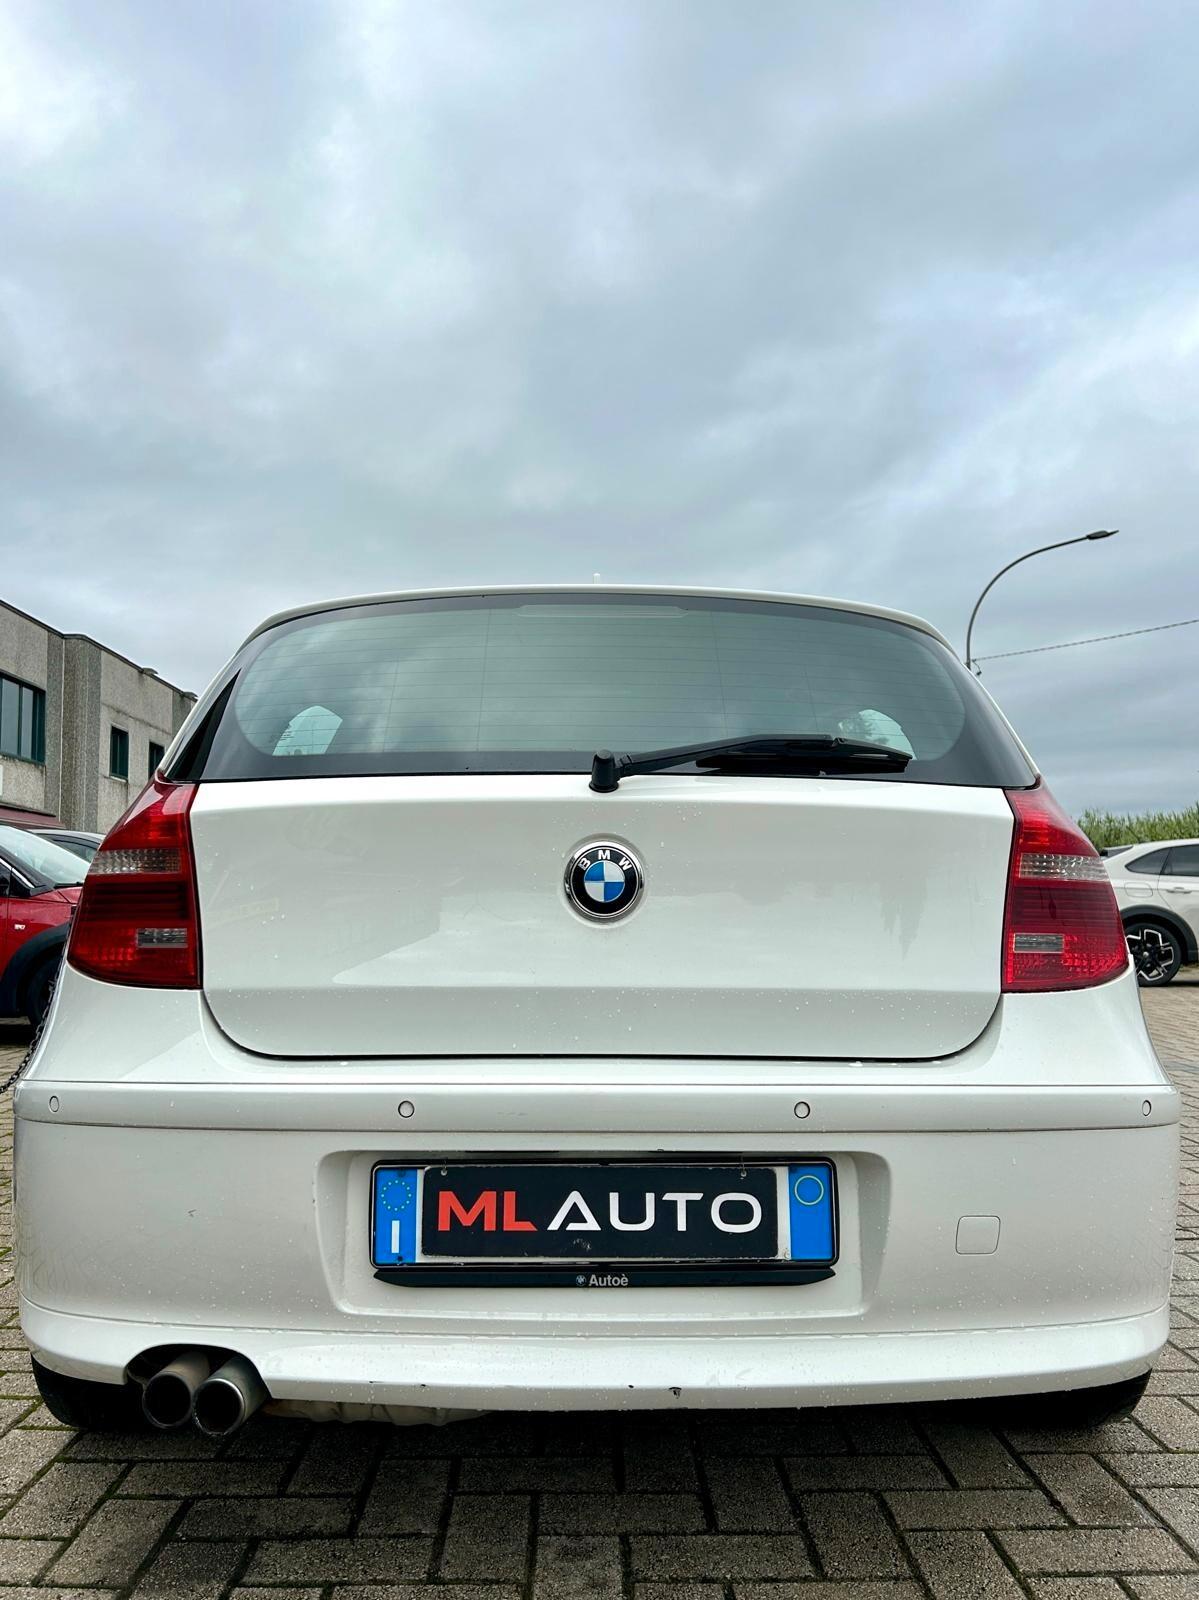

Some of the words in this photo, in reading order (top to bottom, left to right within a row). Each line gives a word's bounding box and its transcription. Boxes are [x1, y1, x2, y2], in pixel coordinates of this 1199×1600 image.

[578, 849, 632, 871] BMW
[437, 1190, 538, 1231] ML
[546, 1190, 762, 1233] AUTO
[391, 1220, 400, 1253] I
[588, 1273, 629, 1287] Autoè
